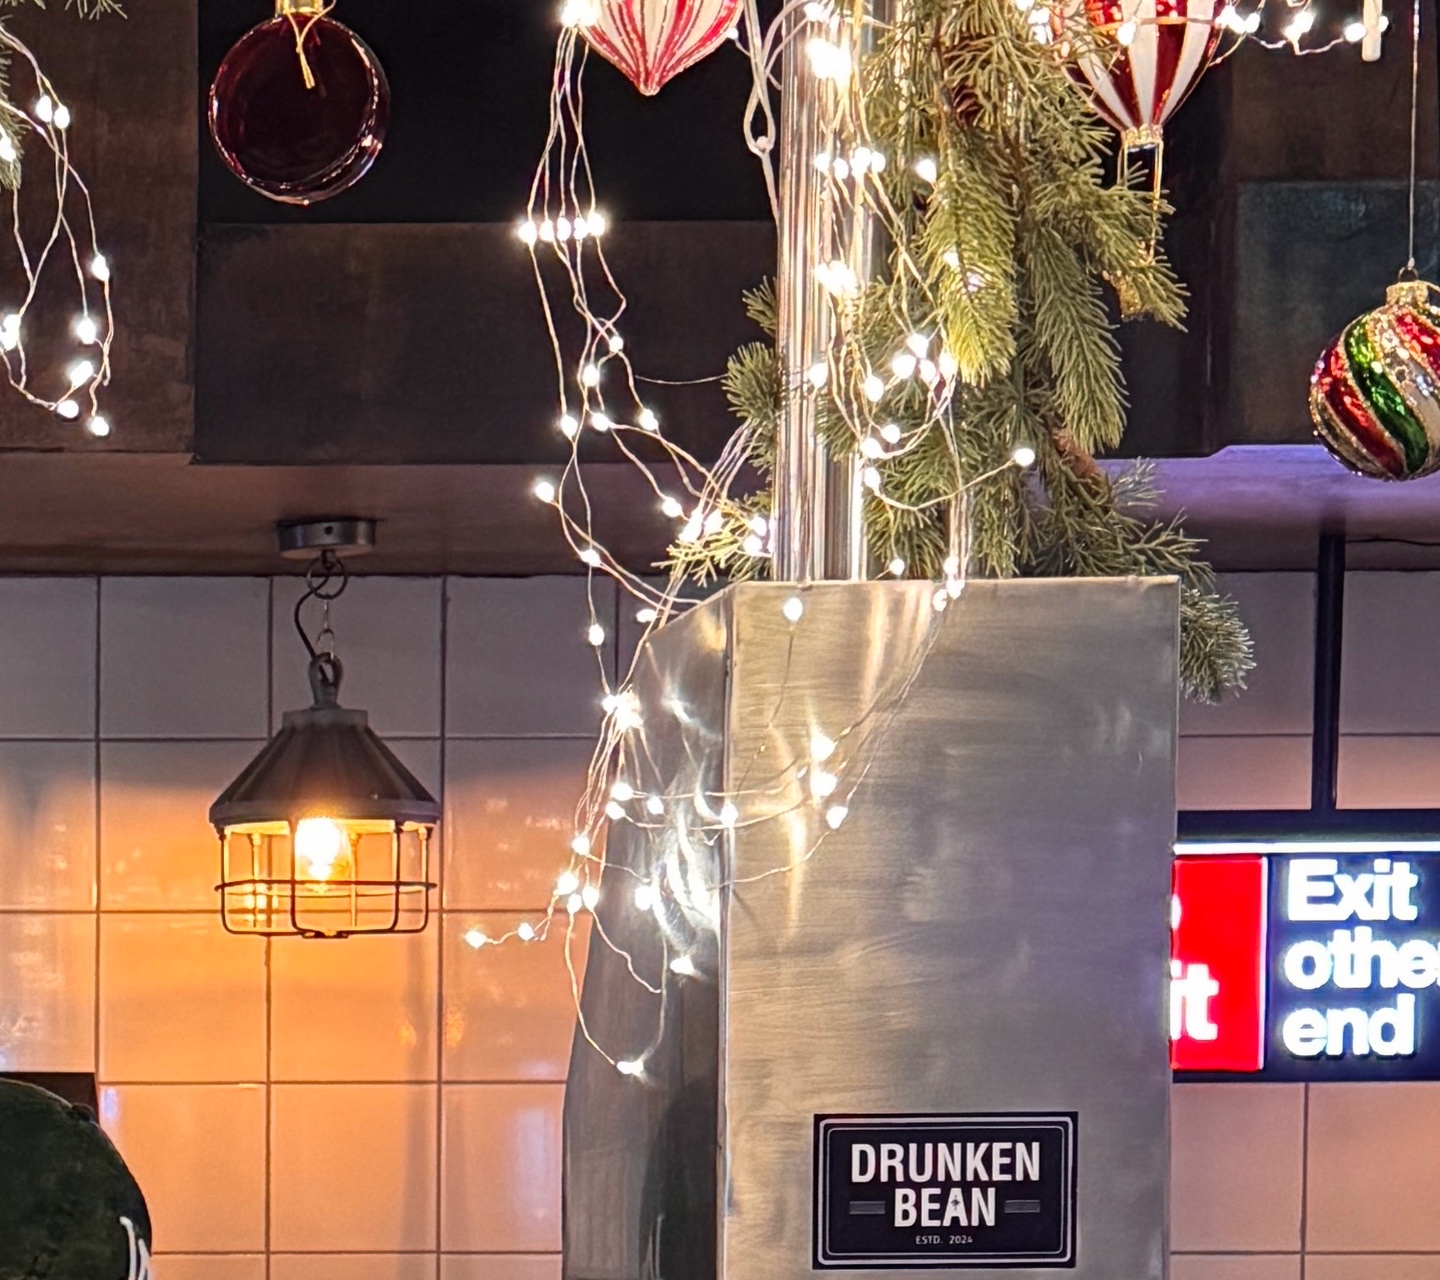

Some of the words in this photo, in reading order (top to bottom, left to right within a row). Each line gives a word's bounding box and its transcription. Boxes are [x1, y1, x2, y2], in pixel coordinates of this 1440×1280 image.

[1287, 858, 1419, 921] Exit
[1283, 926, 1440, 989] othe
[1282, 993, 1416, 1056] end
[851, 1142, 1040, 1182] DRUNKEN
[894, 1187, 996, 1227] BEAN
[915, 1235, 943, 1244] ESTD.
[949, 1235, 973, 1244] 2024
